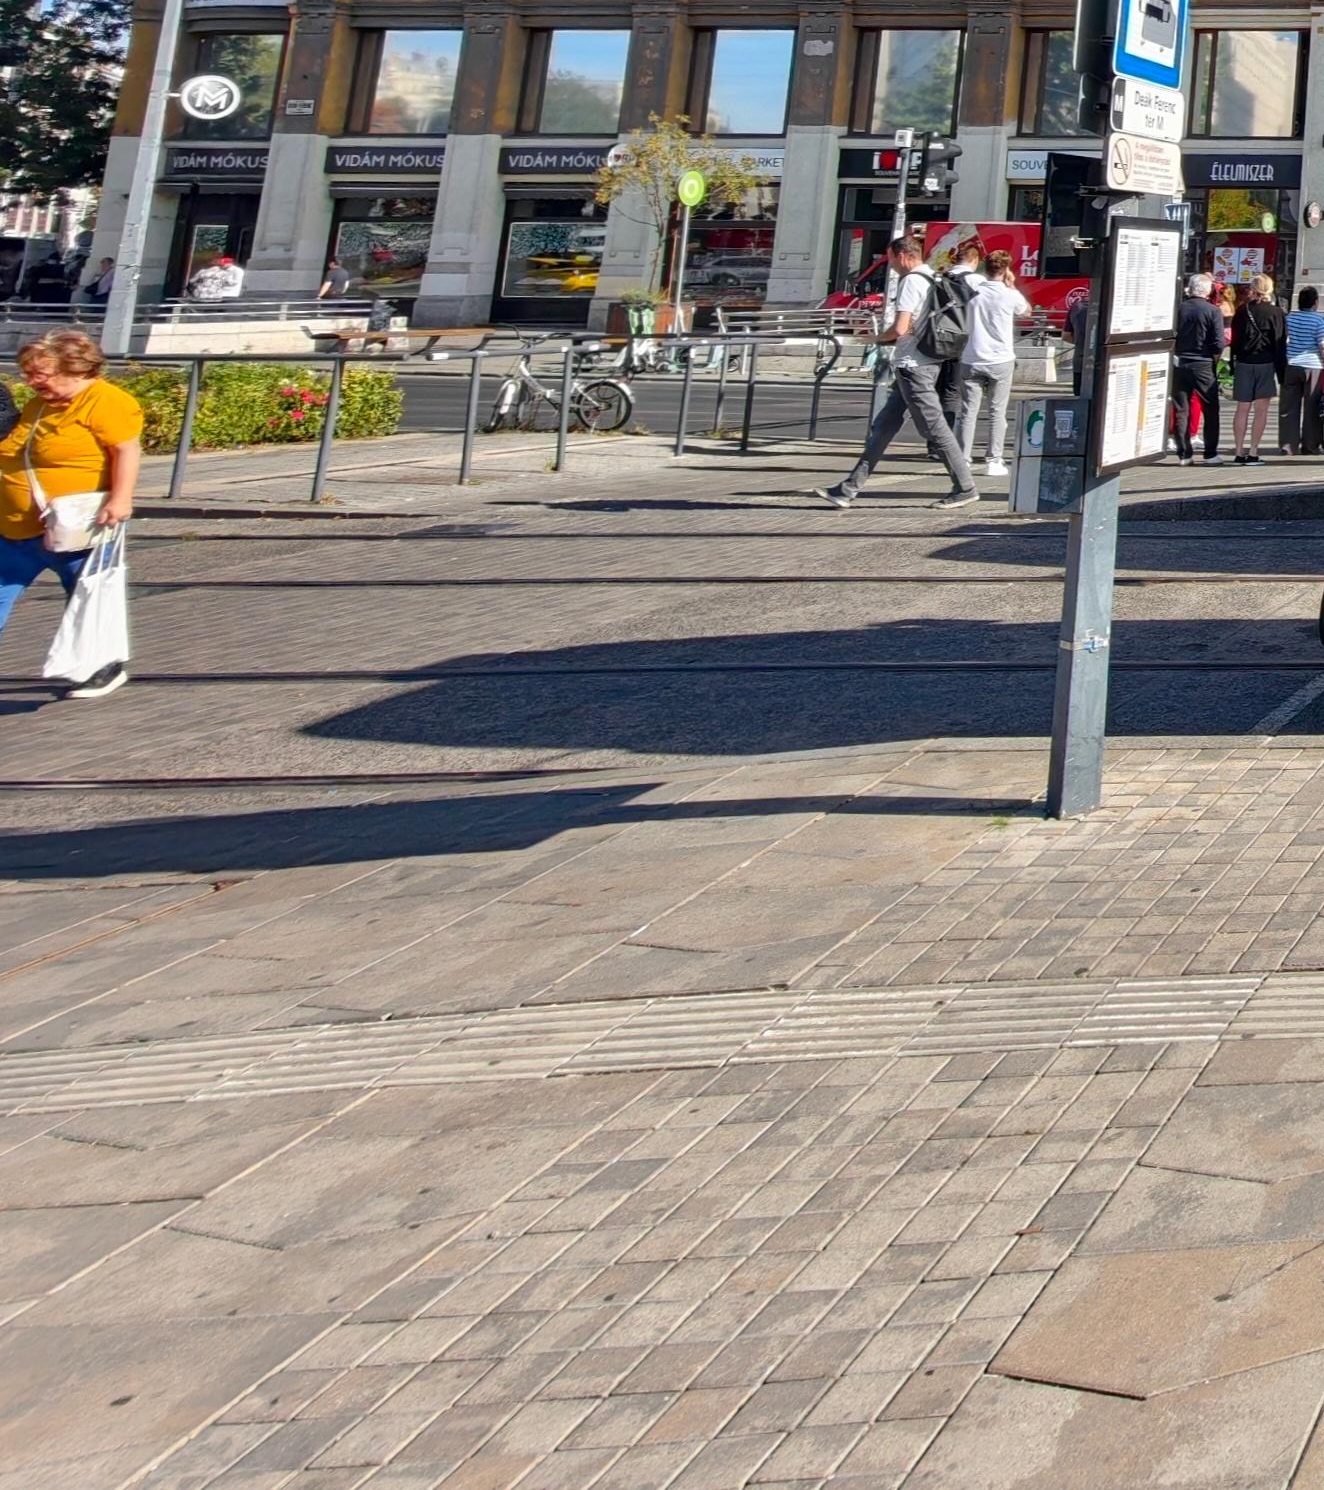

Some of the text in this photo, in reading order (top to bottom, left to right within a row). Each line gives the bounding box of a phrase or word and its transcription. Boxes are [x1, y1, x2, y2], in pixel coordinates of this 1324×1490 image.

[173, 152, 270, 168] VIDÁM MÓKUS
[335, 151, 446, 167] VIDÁM MÓKUS
[508, 151, 558, 168] VIDÁM
[1210, 161, 1274, 181] ÉLELMISZER
